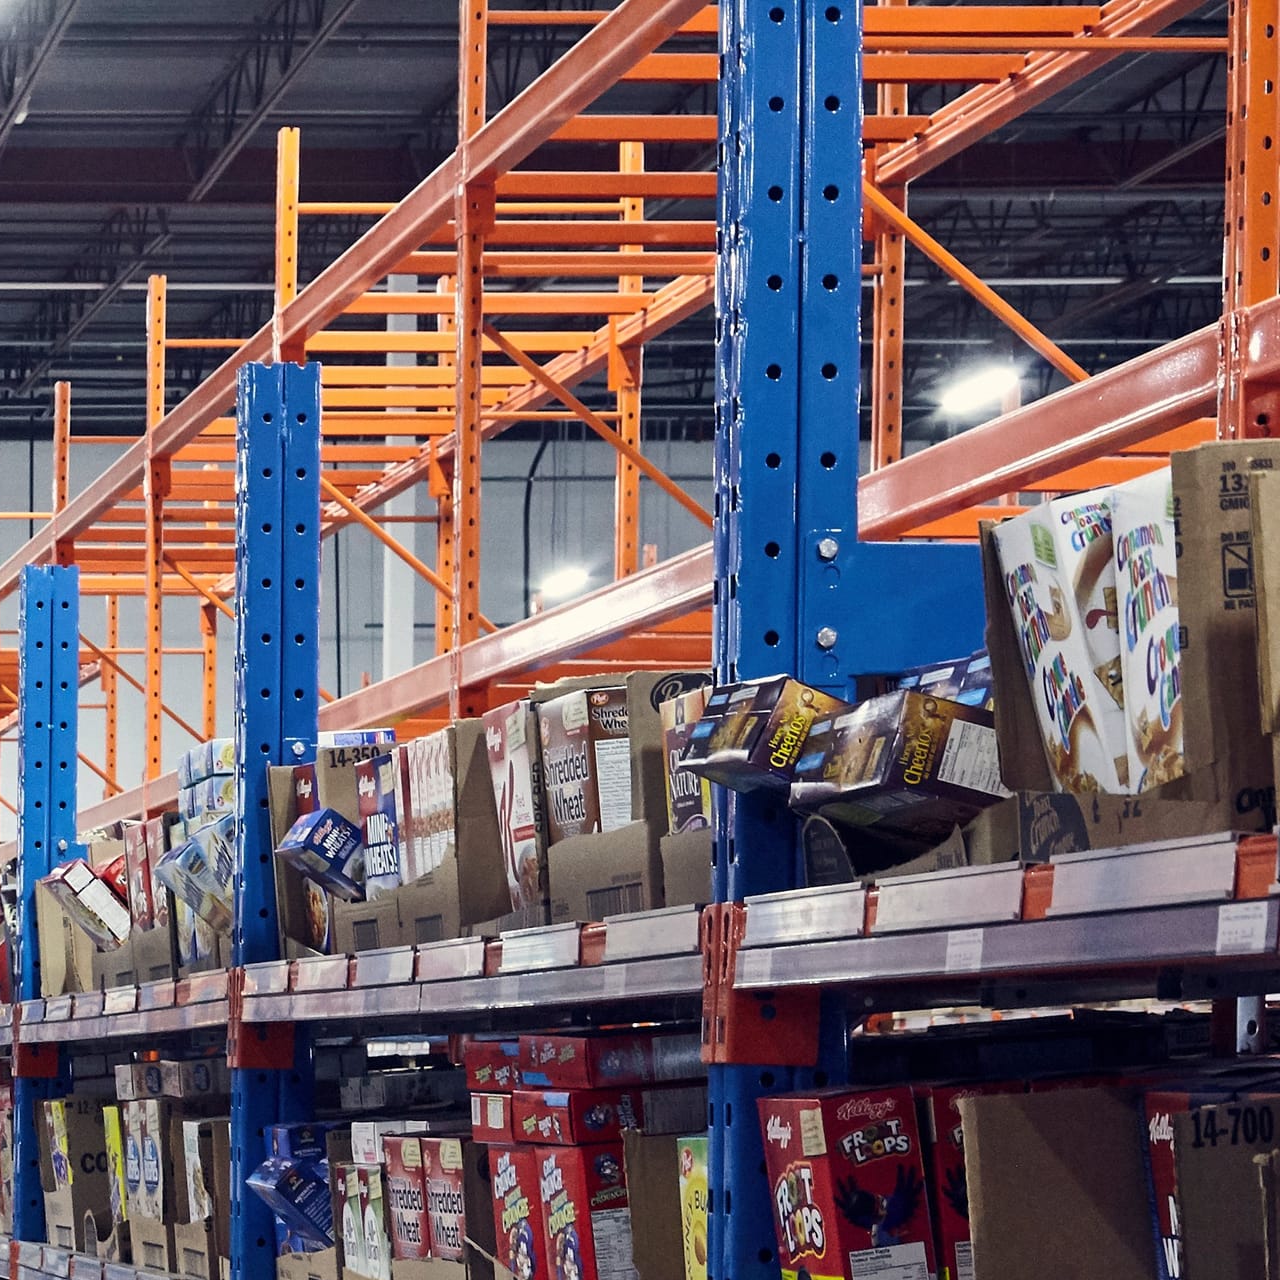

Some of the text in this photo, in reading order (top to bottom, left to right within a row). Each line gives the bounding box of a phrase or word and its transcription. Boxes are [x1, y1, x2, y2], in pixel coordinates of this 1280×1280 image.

[1118, 523, 1163, 572] Cinnamon
[1128, 550, 1154, 591] Toast
[1126, 570, 1169, 652] Crunch
[601, 718, 627, 730] Whe
[770, 712, 806, 768] Cheerios
[544, 741, 589, 789] Shredded
[904, 726, 933, 785] Cheerios
[671, 770, 701, 801] NATURE
[553, 790, 587, 824] Wheat
[364, 845, 398, 877] WHEATS!
[837, 1099, 895, 1120] Kellogg's
[1192, 1105, 1274, 1148] 14-700
[397, 1217, 420, 1243] Wheat
[436, 1220, 459, 1249] Wheat
